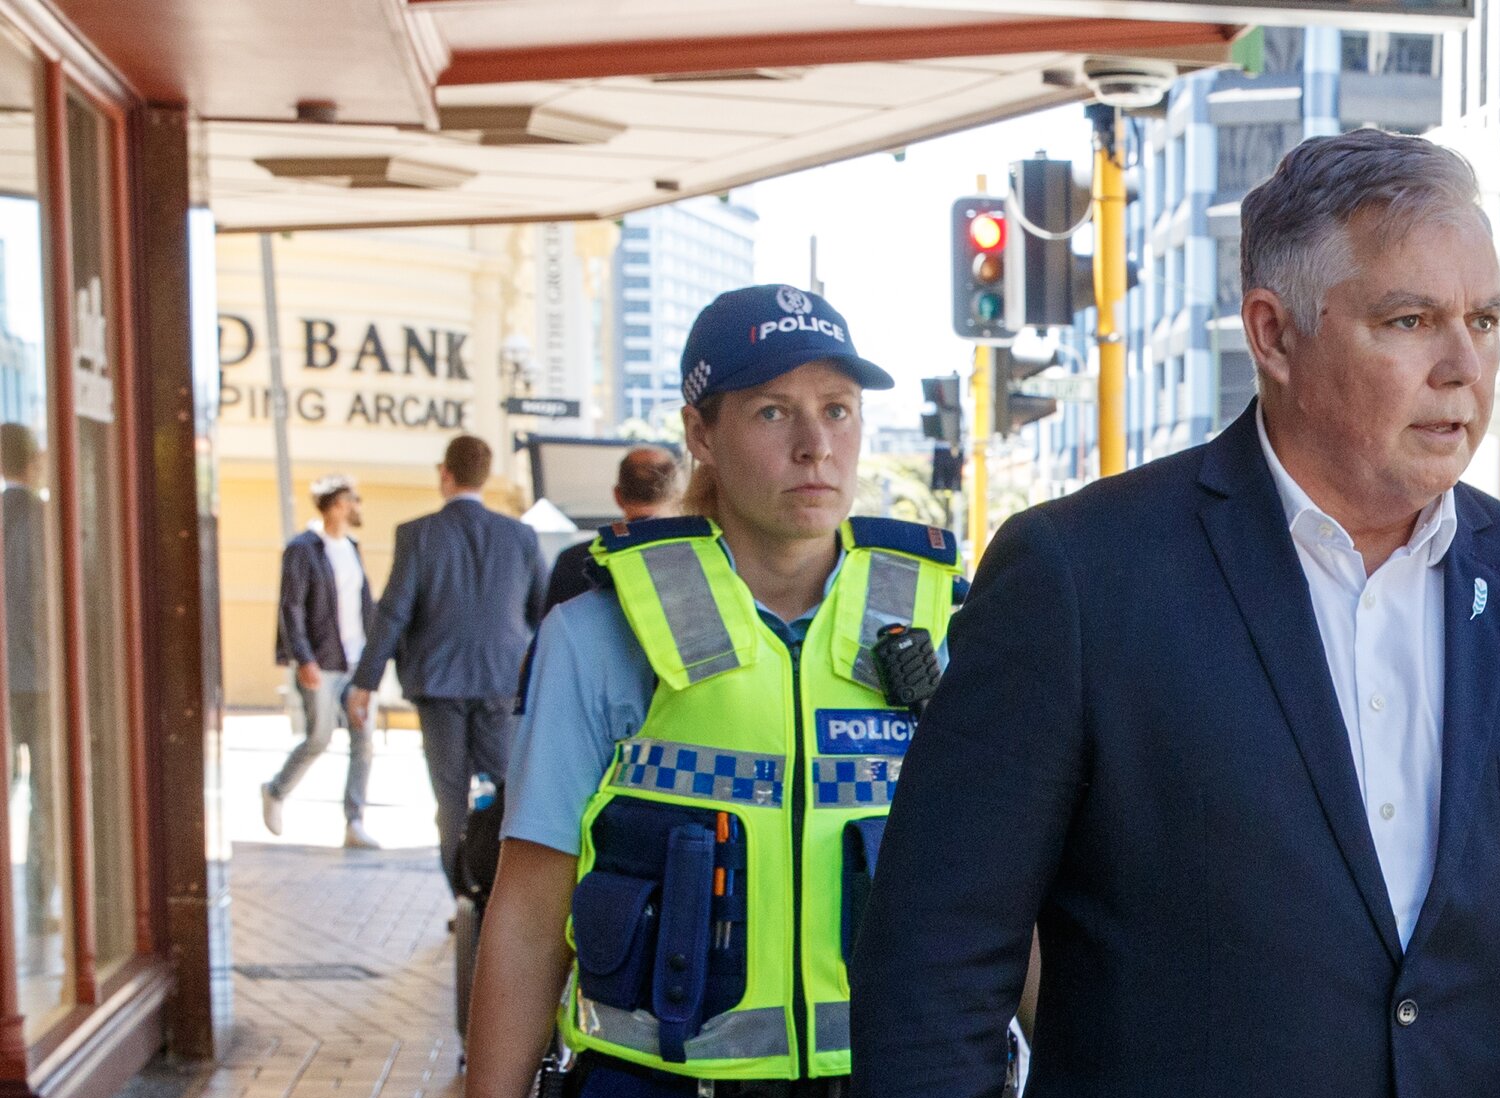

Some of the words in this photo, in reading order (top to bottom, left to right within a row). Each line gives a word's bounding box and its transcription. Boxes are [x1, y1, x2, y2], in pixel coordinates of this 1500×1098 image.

[760, 315, 845, 343] POLICE
[300, 317, 470, 380] BANK
[347, 392, 465, 429] ARCADE
